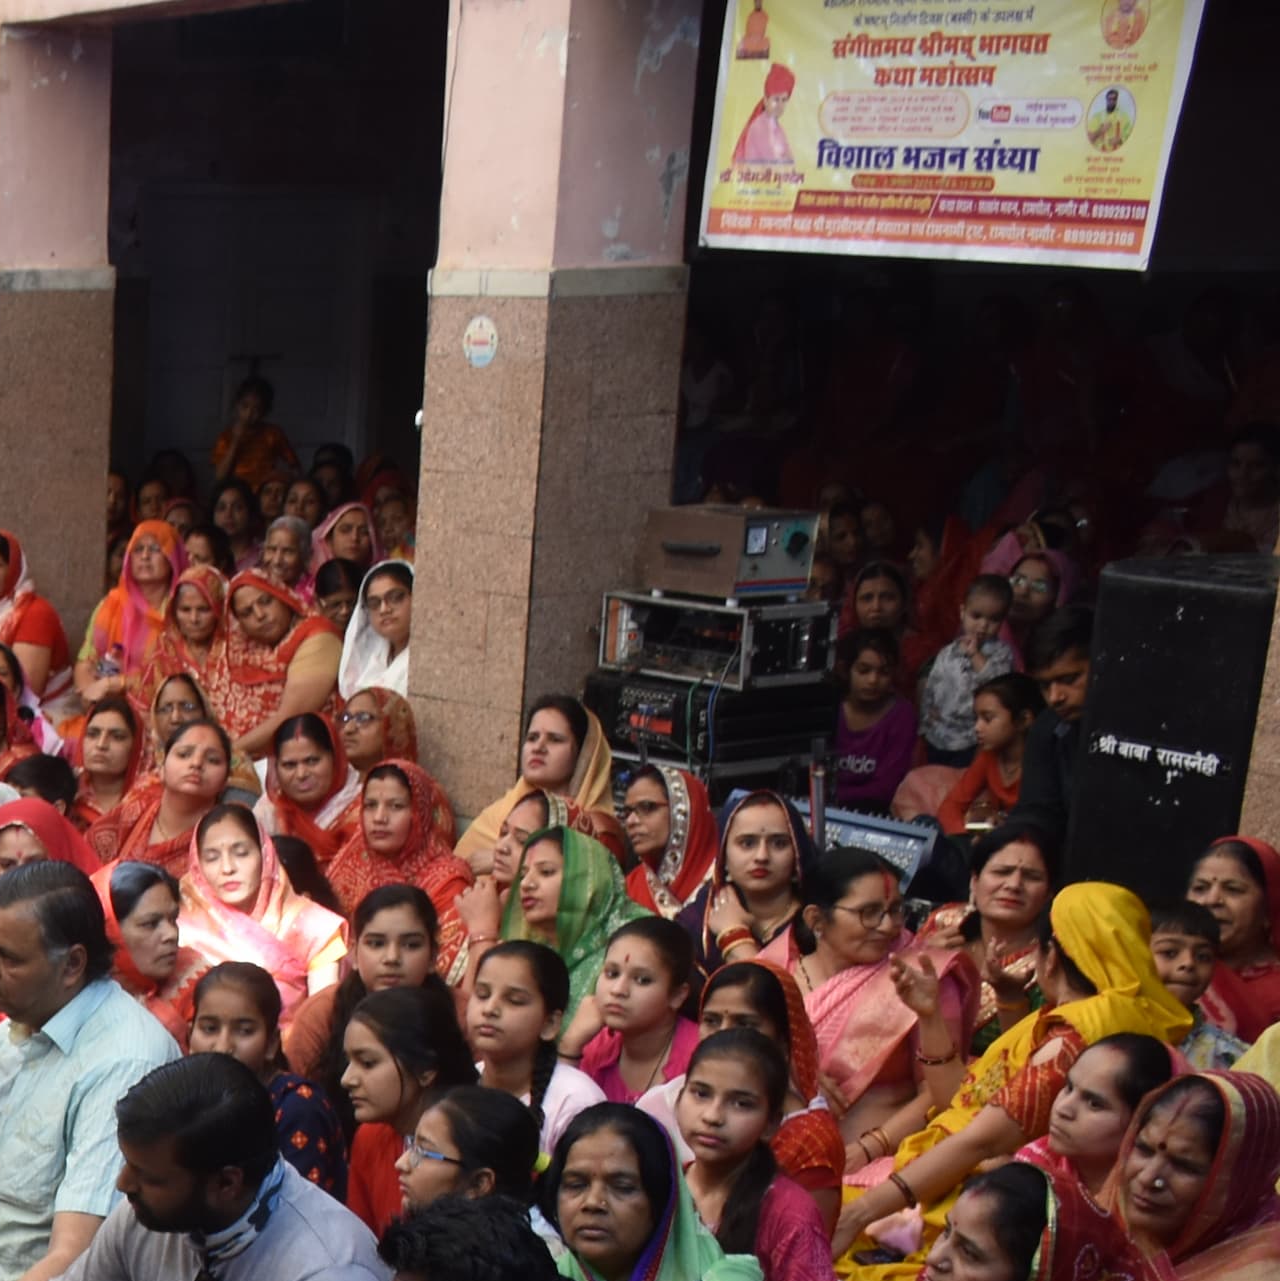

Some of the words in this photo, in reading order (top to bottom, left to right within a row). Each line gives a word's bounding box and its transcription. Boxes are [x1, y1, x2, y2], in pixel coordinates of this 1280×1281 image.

[833, 31, 915, 58] संगीतमय
[979, 32, 1051, 55] भागवत
[874, 66, 915, 86] कथा
[919, 61, 997, 87] महोत्सव
[817, 138, 897, 170] विशाल
[903, 147, 969, 172] भजन
[973, 138, 1040, 173] संध्या
[1098, 734, 1117, 755] श्री
[1118, 740, 1151, 762] बाबा
[1155, 750, 1220, 776] रामस्नेही
